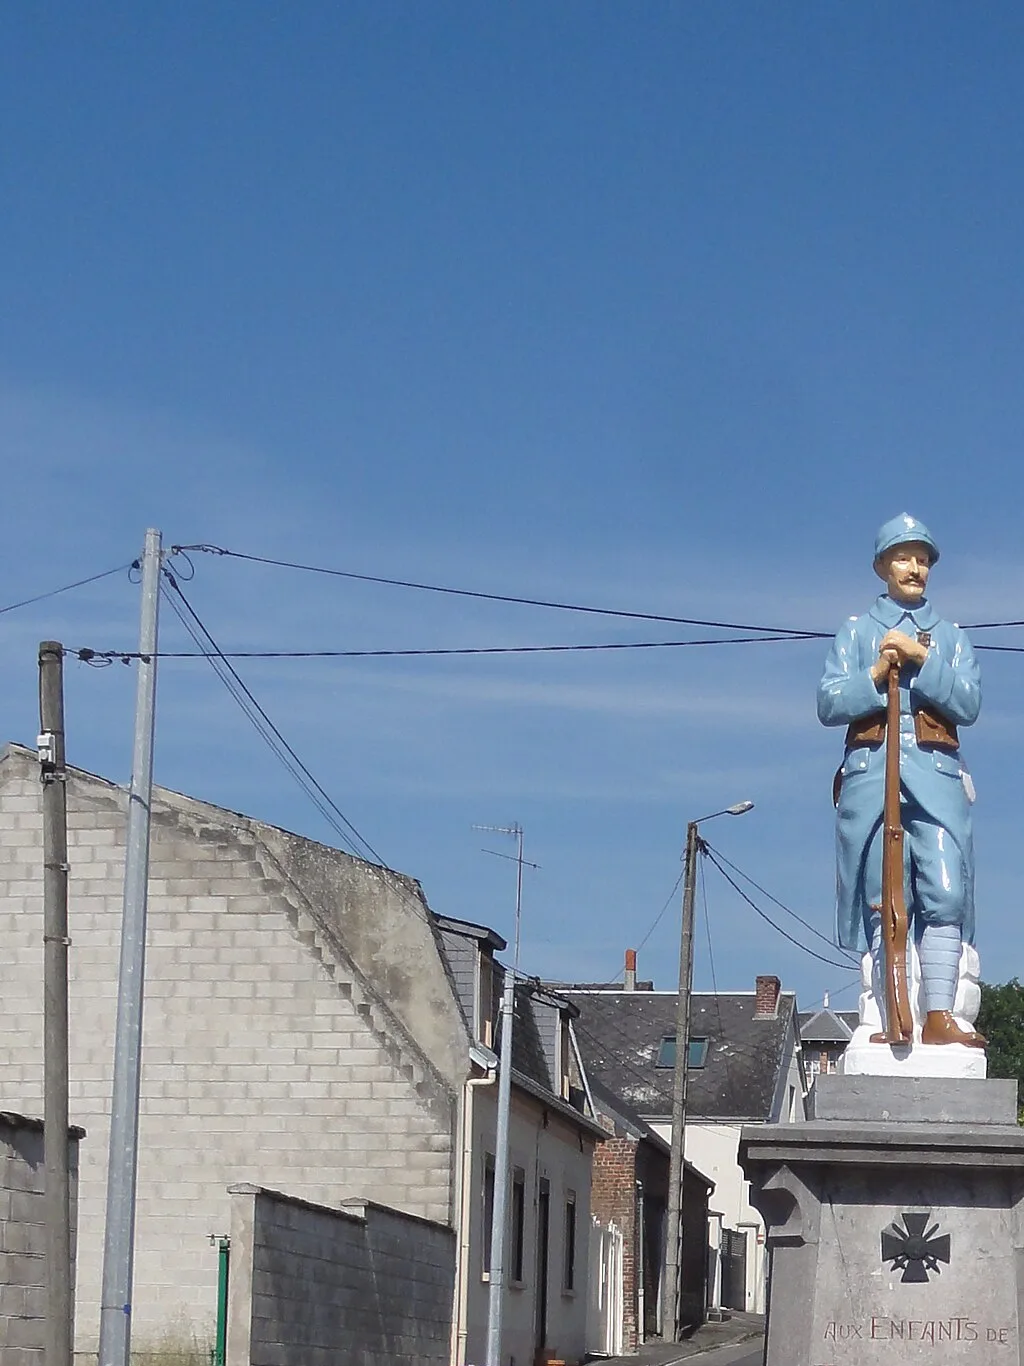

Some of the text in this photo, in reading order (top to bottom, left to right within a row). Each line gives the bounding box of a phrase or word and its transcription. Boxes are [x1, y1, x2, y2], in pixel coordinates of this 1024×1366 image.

[824, 1316, 1009, 1347] AUX ENFANTS DE
